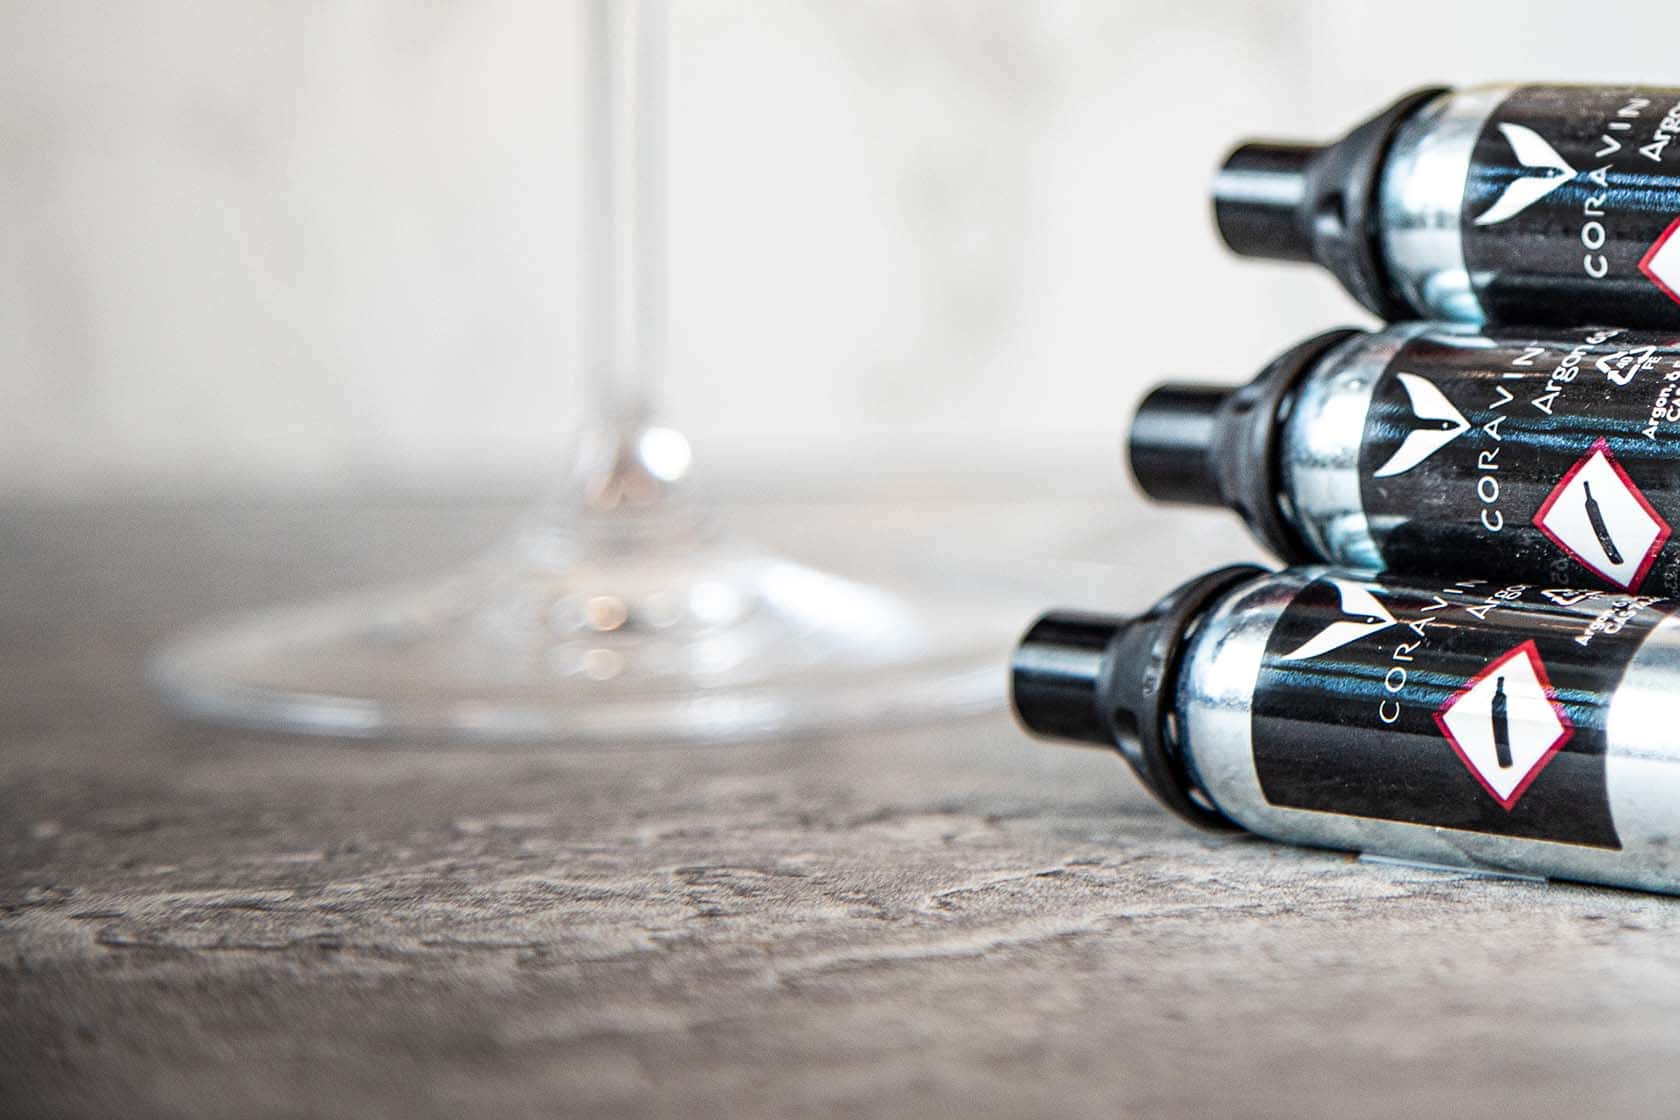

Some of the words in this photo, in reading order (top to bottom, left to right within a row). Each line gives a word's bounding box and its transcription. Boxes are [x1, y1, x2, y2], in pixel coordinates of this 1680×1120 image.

[1581, 97, 1650, 279] CORAVIN
[1531, 344, 1594, 415] Argon
[1642, 356, 1661, 371] FE
[1477, 347, 1545, 532] CORAVIN
[1642, 383, 1678, 441] Argon,
